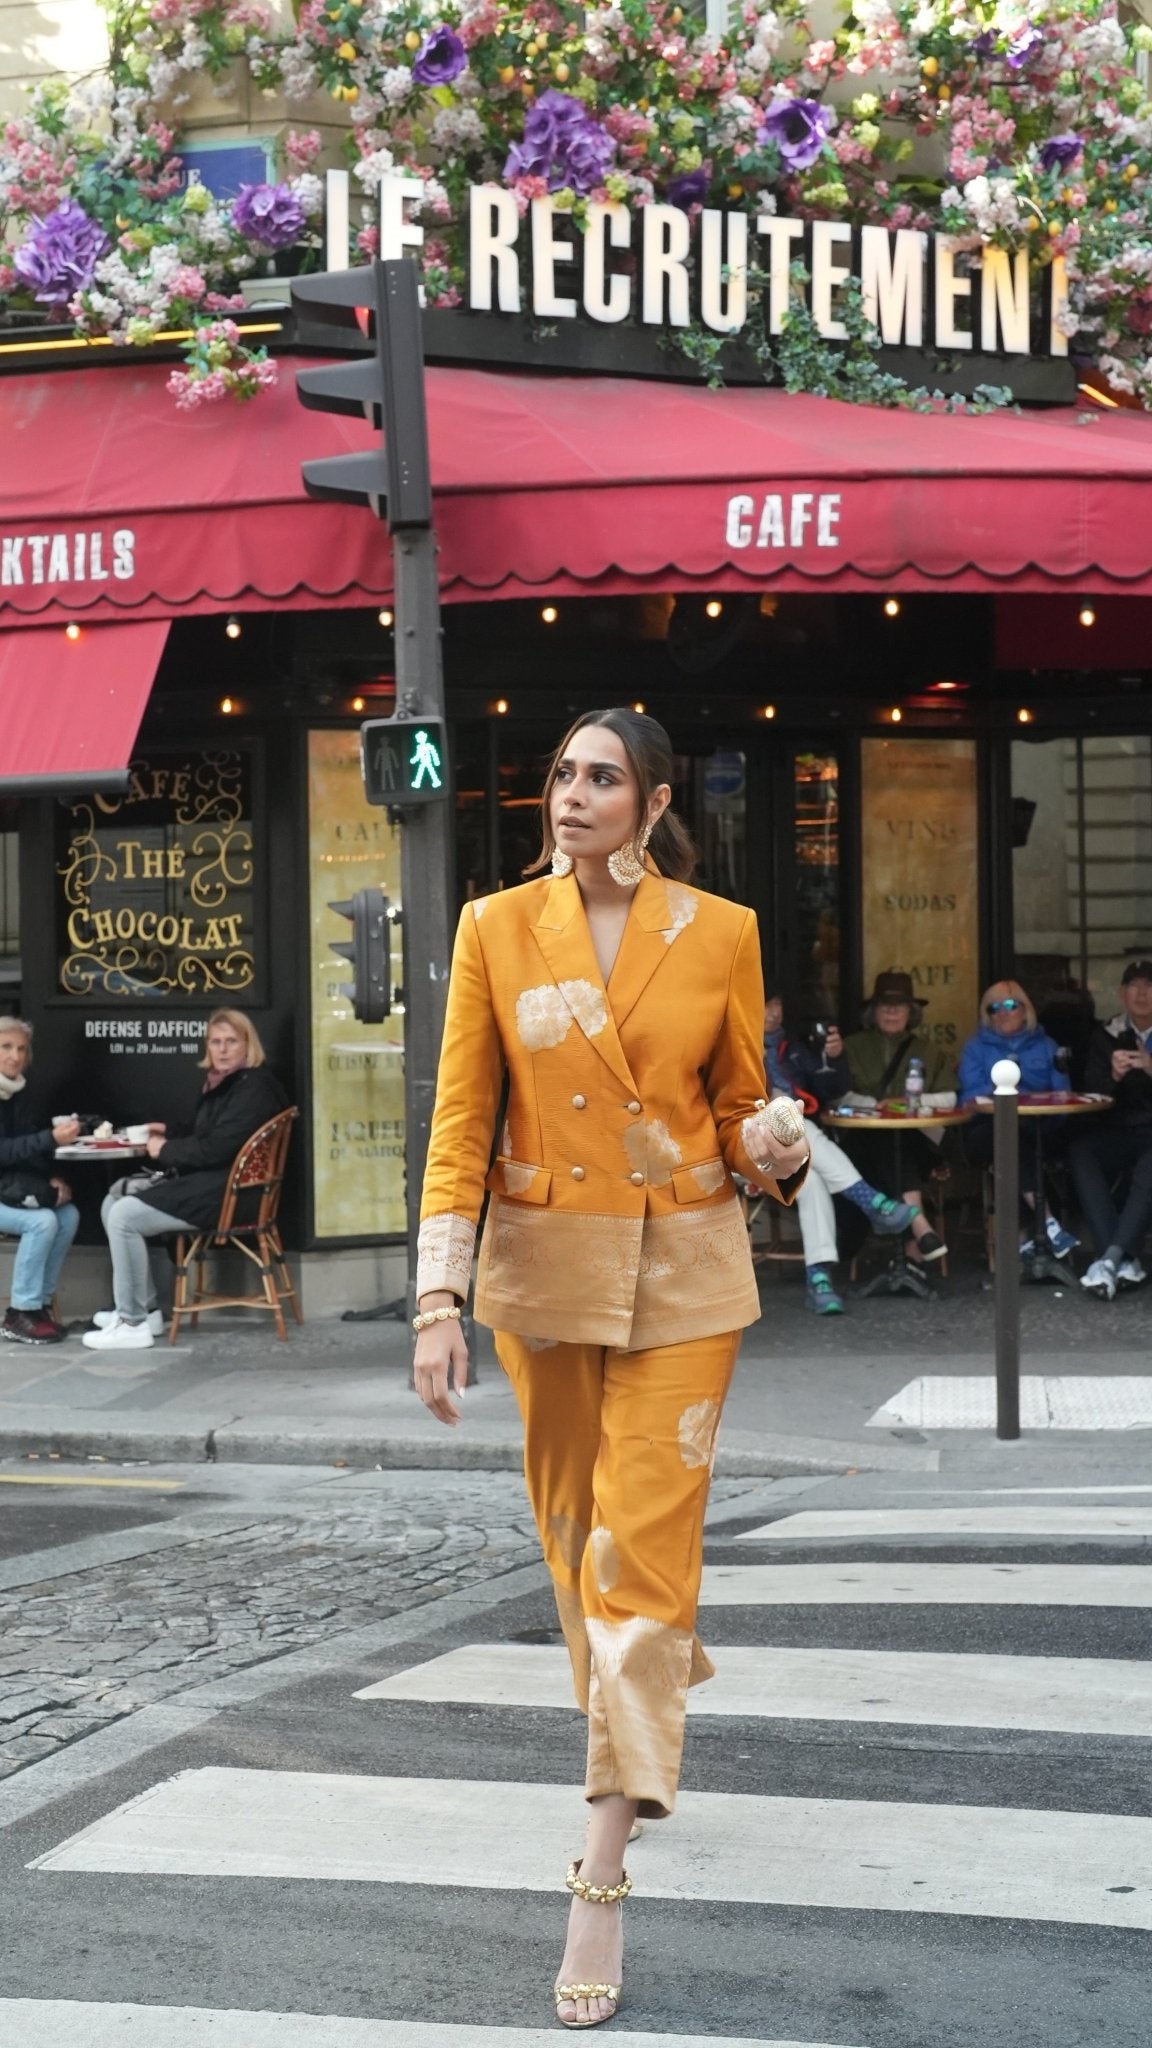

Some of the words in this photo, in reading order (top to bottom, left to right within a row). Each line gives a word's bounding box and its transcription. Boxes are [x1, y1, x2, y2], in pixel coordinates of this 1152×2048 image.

[726, 493, 842, 548] CAFE
[1, 529, 135, 586] KTAILS
[116, 842, 186, 879] THÉ
[67, 908, 244, 950] CHOCOLAT
[85, 1020, 143, 1038] DEFENSE
